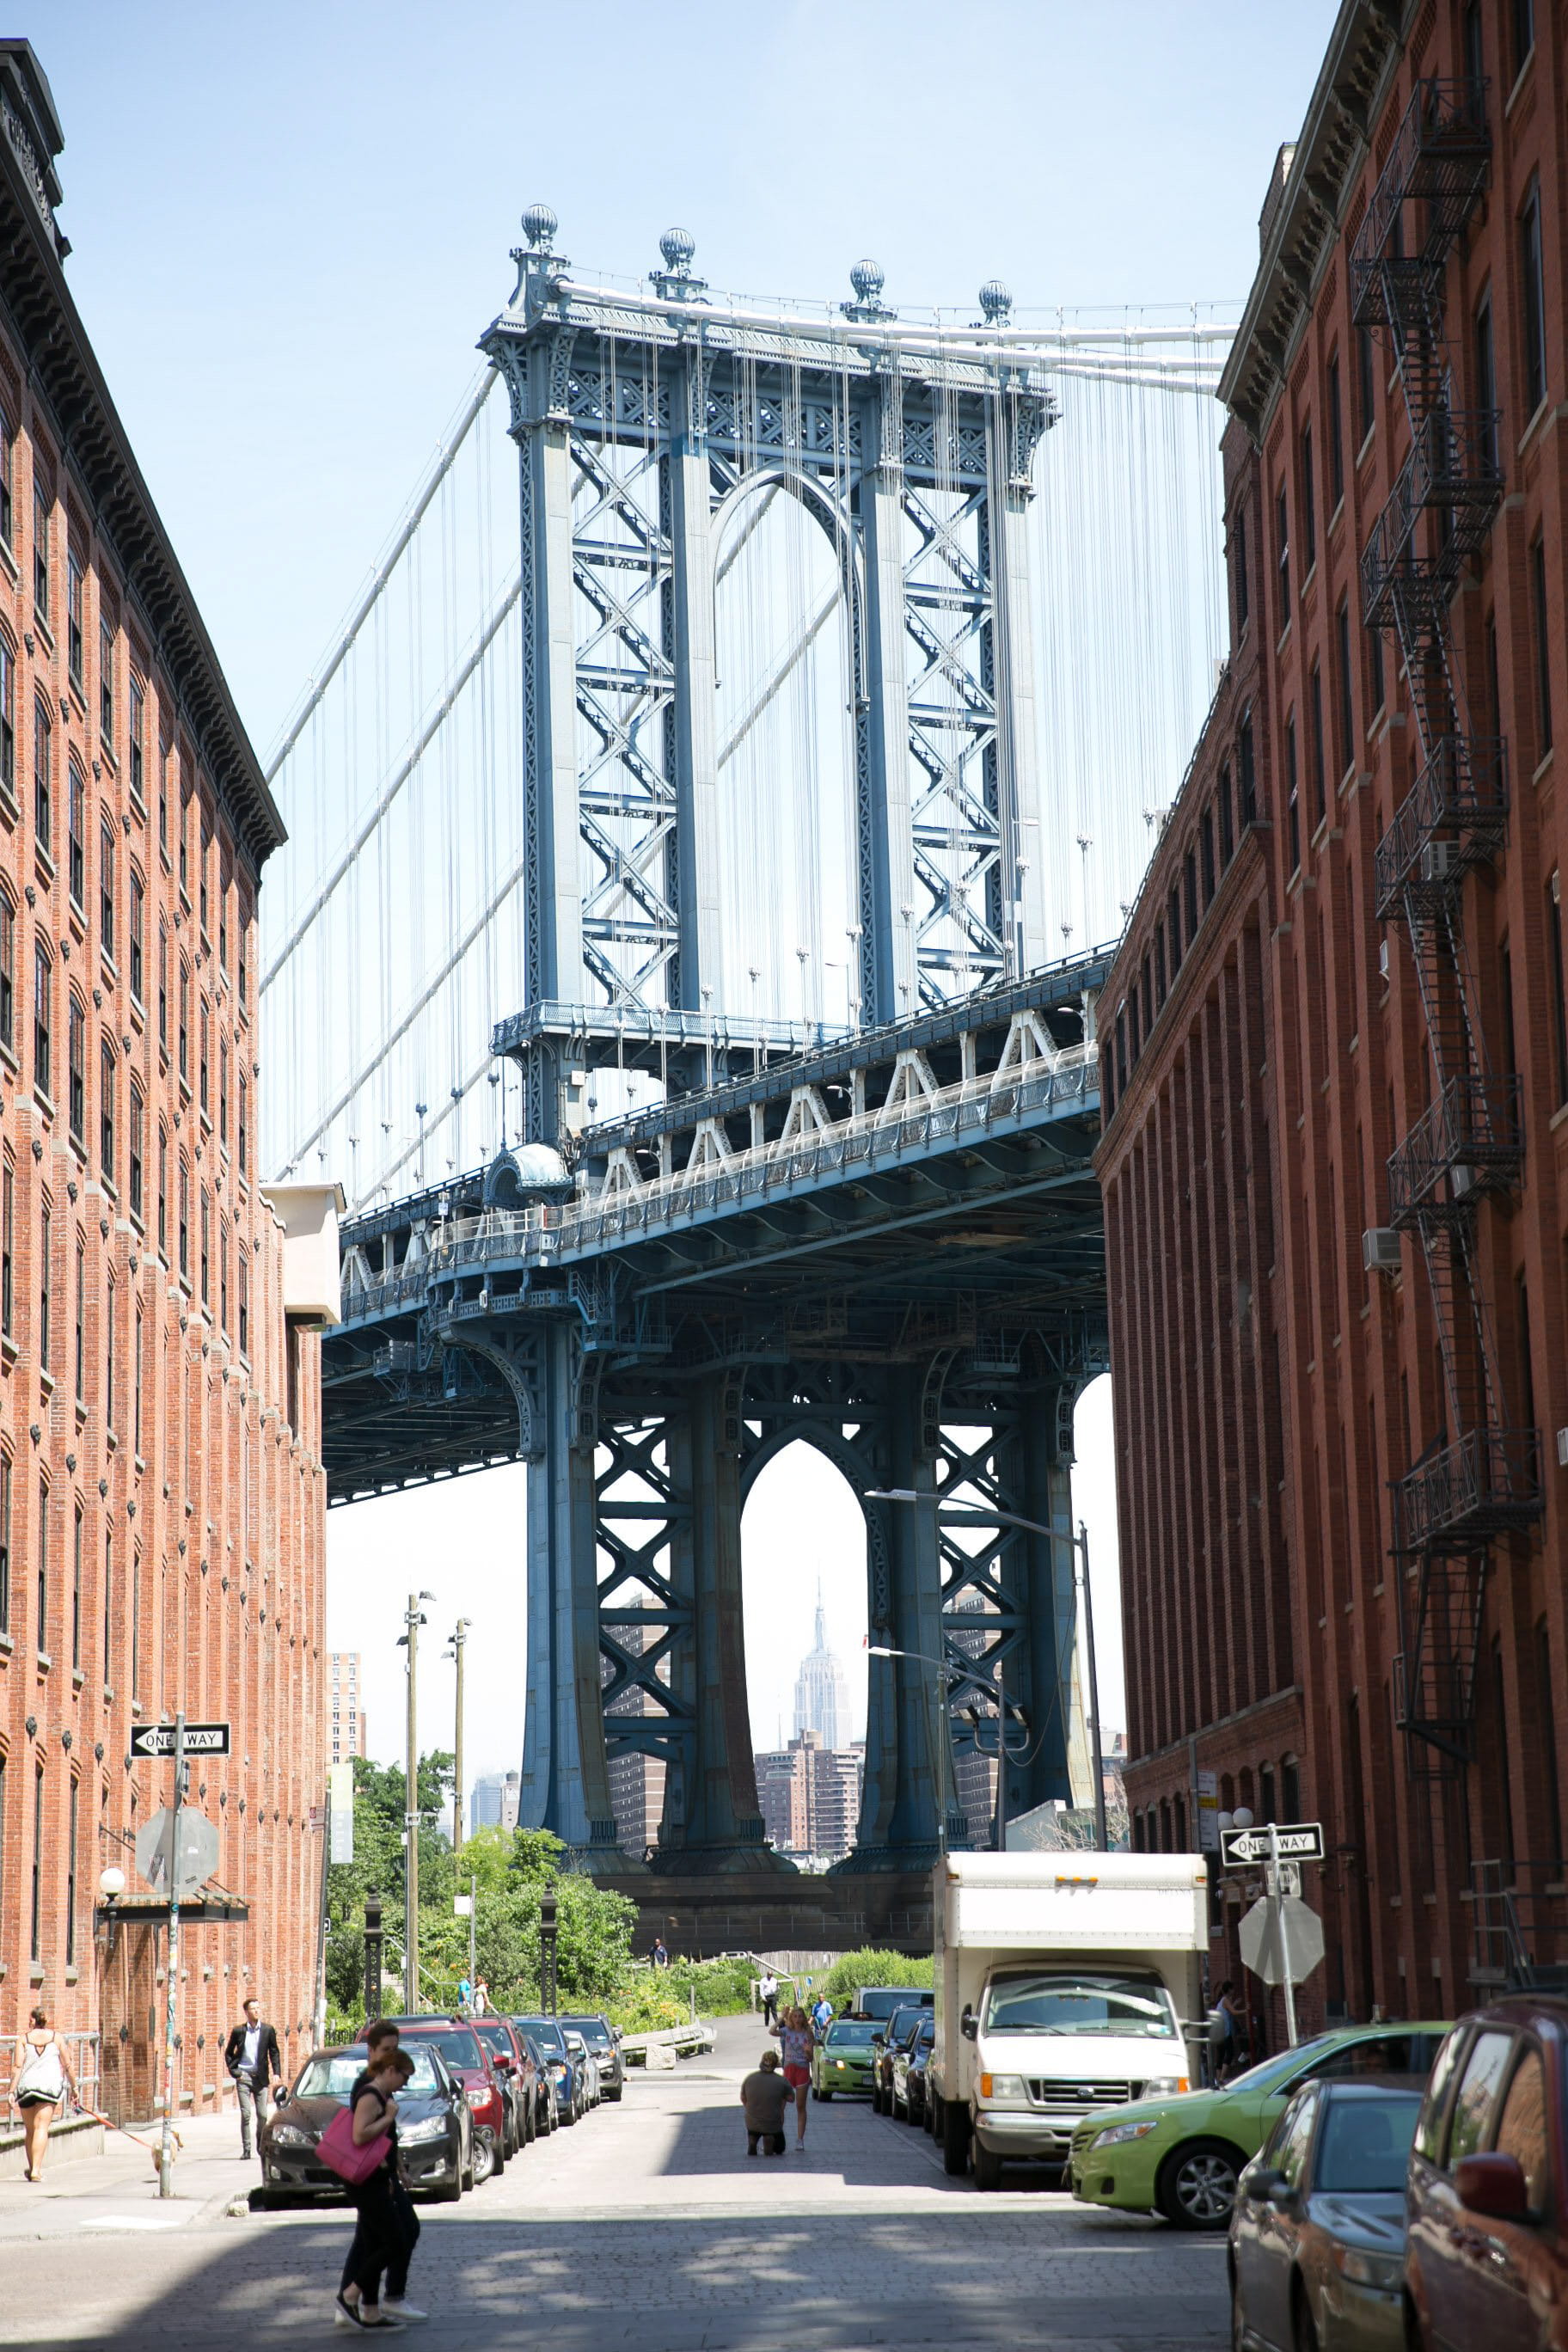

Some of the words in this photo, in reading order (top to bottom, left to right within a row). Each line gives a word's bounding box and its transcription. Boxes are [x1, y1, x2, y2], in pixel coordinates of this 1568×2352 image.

[146, 1735, 173, 1747] ONE
[187, 1733, 217, 1746] WAY
[1239, 1840, 1266, 1853] ONE
[1279, 1836, 1308, 1849] WAY
